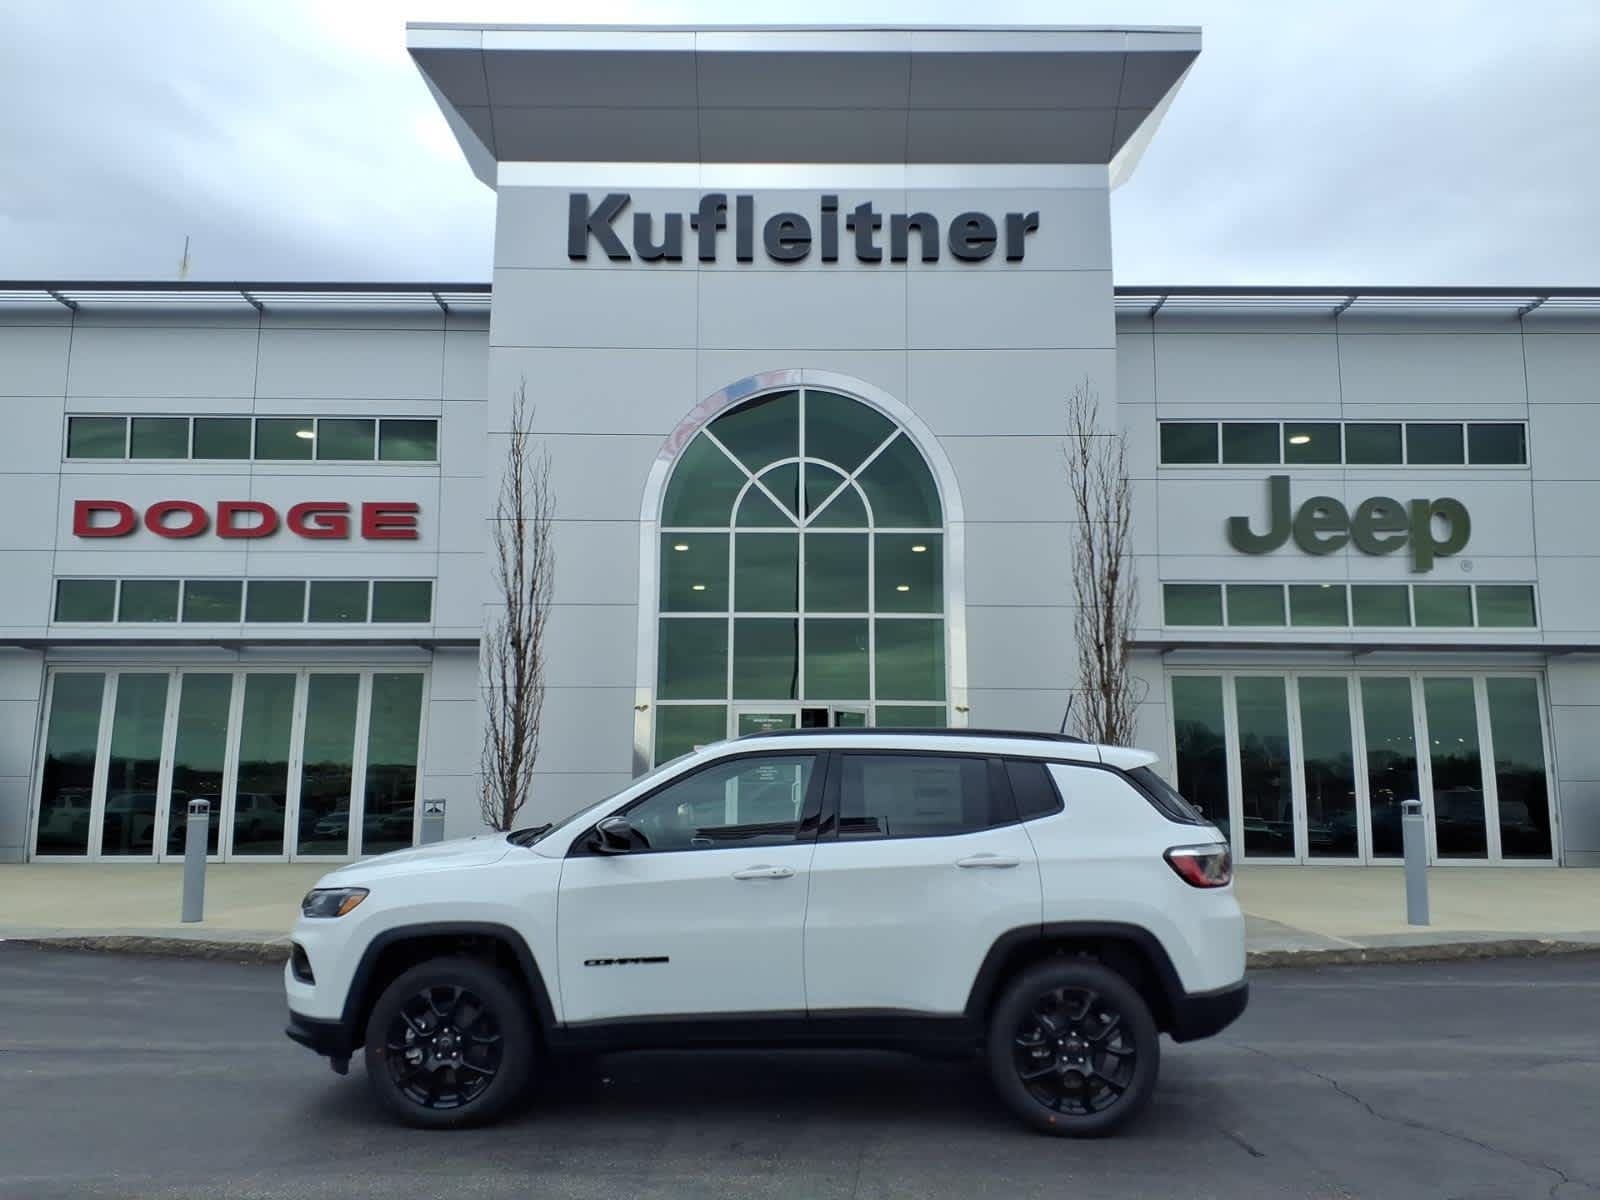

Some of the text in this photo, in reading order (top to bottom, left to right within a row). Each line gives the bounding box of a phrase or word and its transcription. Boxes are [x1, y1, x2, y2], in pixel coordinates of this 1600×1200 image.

[568, 193, 1039, 263] Kufleitner
[73, 500, 419, 539] DODGE
[1227, 475, 1471, 572] Jeep
